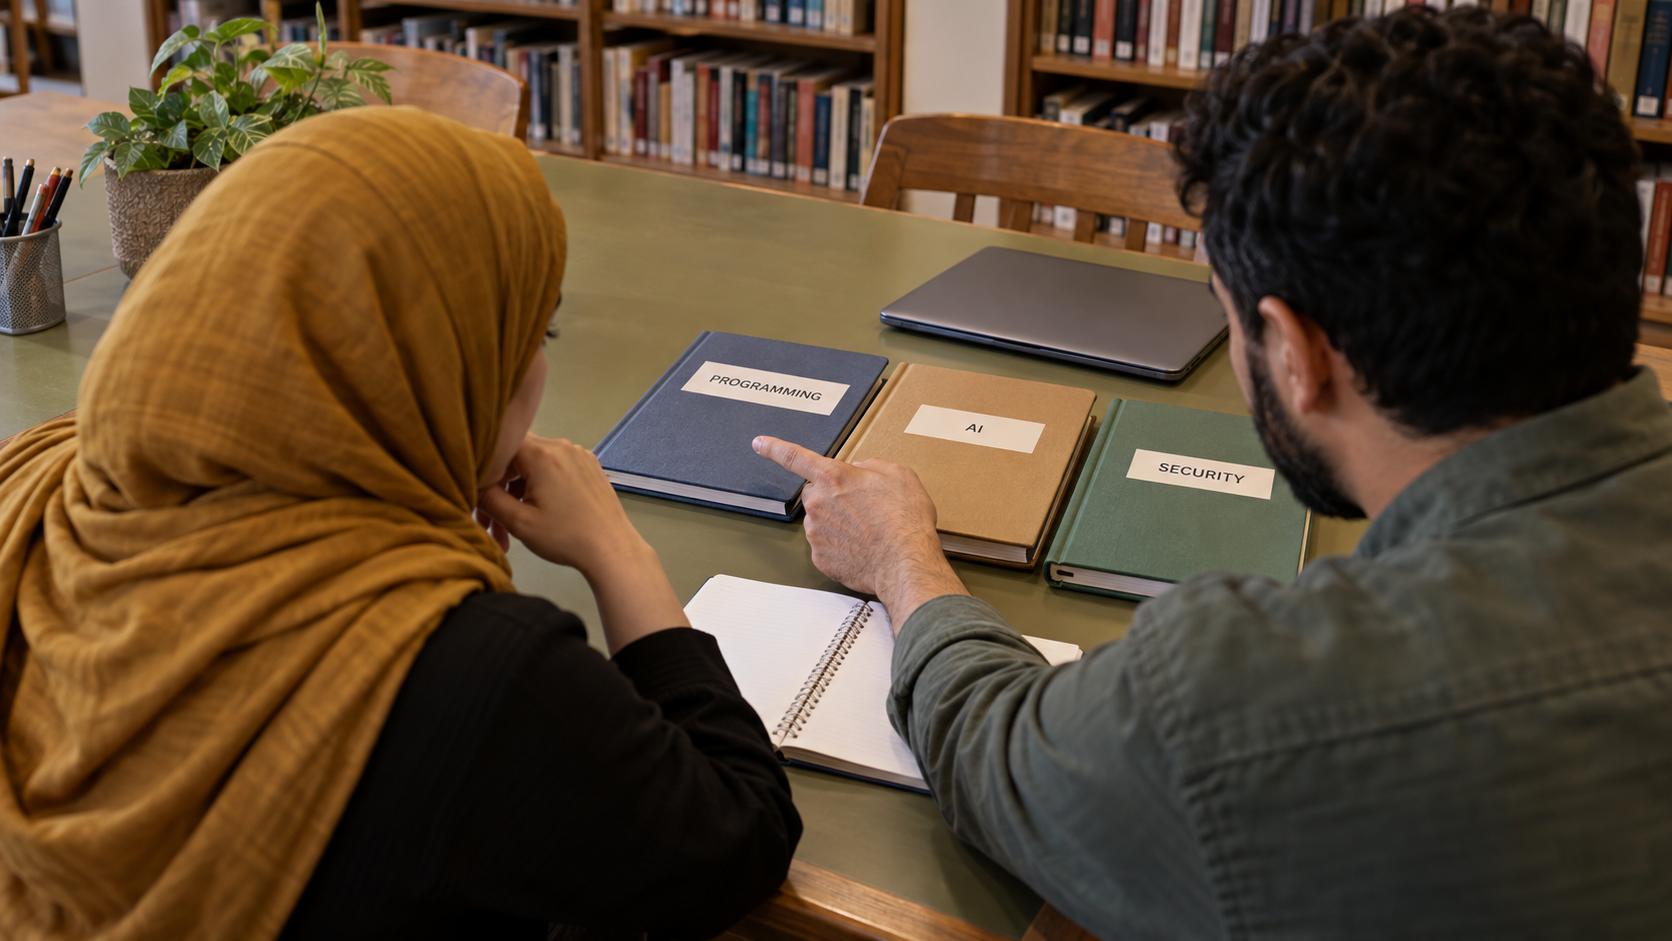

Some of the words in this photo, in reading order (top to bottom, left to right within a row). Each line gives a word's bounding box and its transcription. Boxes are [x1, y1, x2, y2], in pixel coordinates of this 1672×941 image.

[709, 374, 823, 401] PROGRAMMING
[965, 422, 984, 434] AI
[1158, 462, 1245, 484] SECURITY
